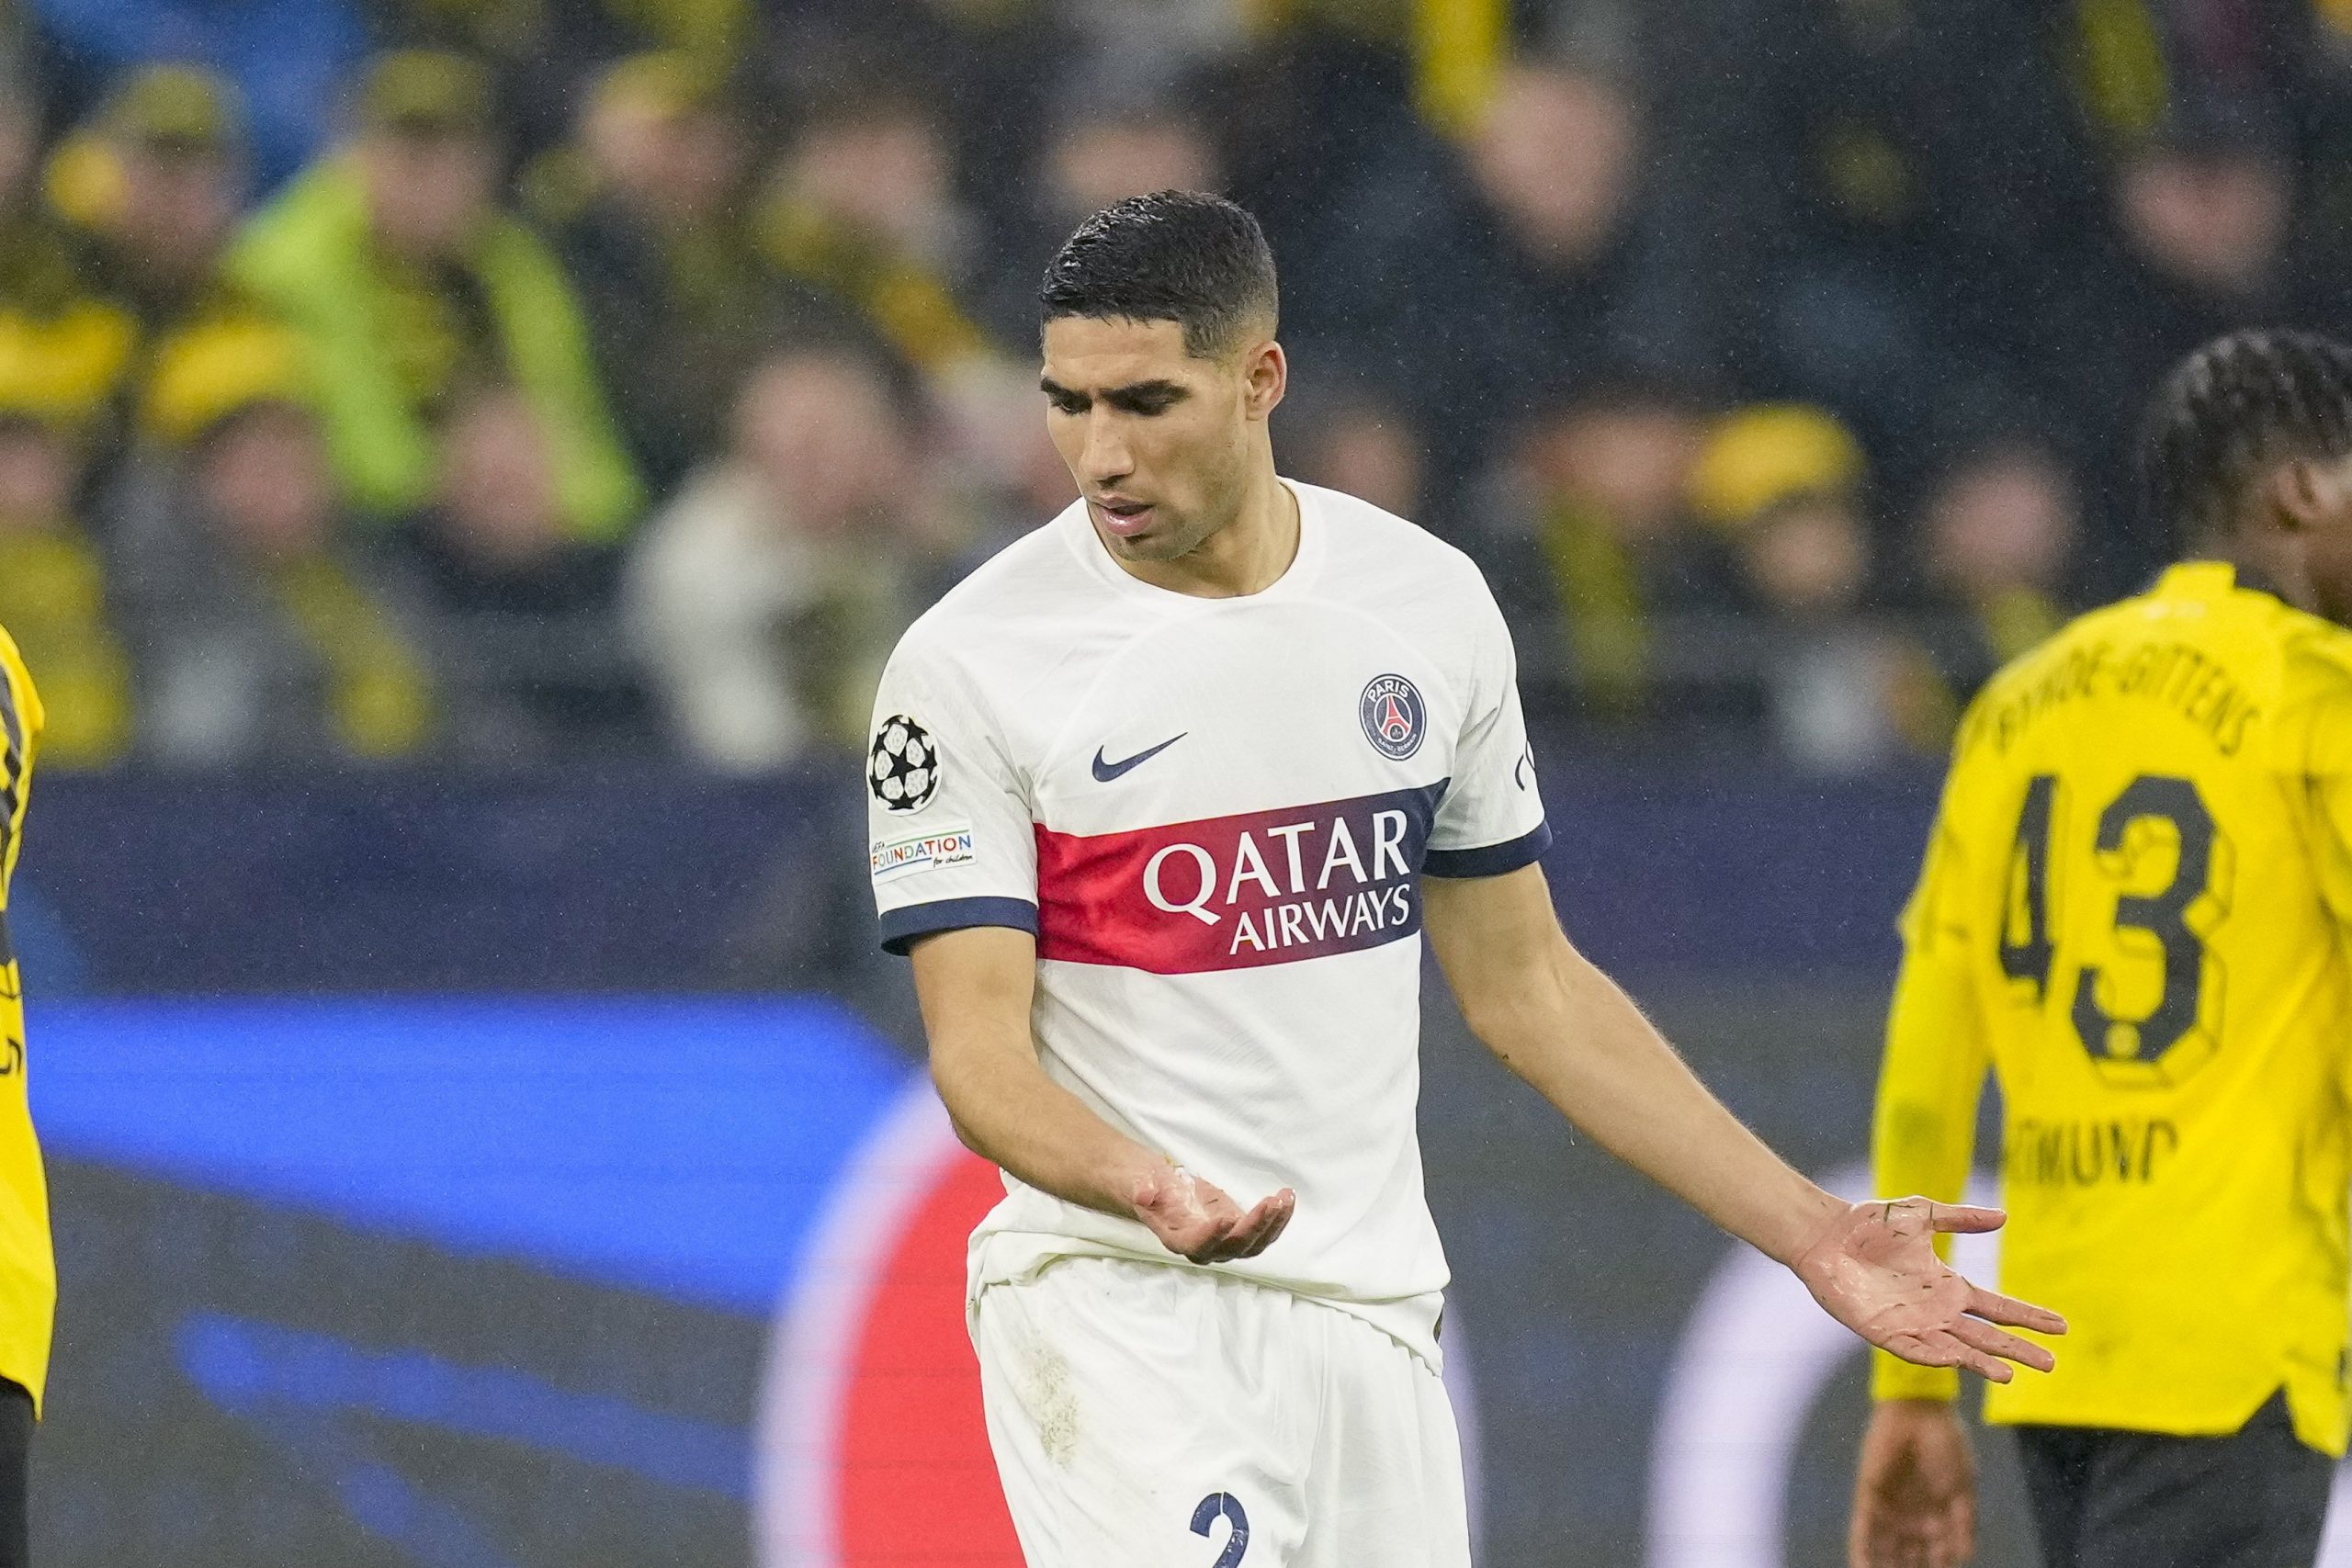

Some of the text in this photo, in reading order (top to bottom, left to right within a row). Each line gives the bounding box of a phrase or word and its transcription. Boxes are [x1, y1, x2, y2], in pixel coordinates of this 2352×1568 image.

[1367, 680, 1409, 702] PARIS
[872, 840, 885, 853] EFA
[872, 835, 971, 870] FOUNDATION
[933, 853, 973, 868] for children
[1143, 809, 1410, 926] QATAR
[1229, 883, 1410, 955] AIRWAYS
[1998, 773, 2220, 1063] 43
[1190, 1492, 1250, 1568] 2
